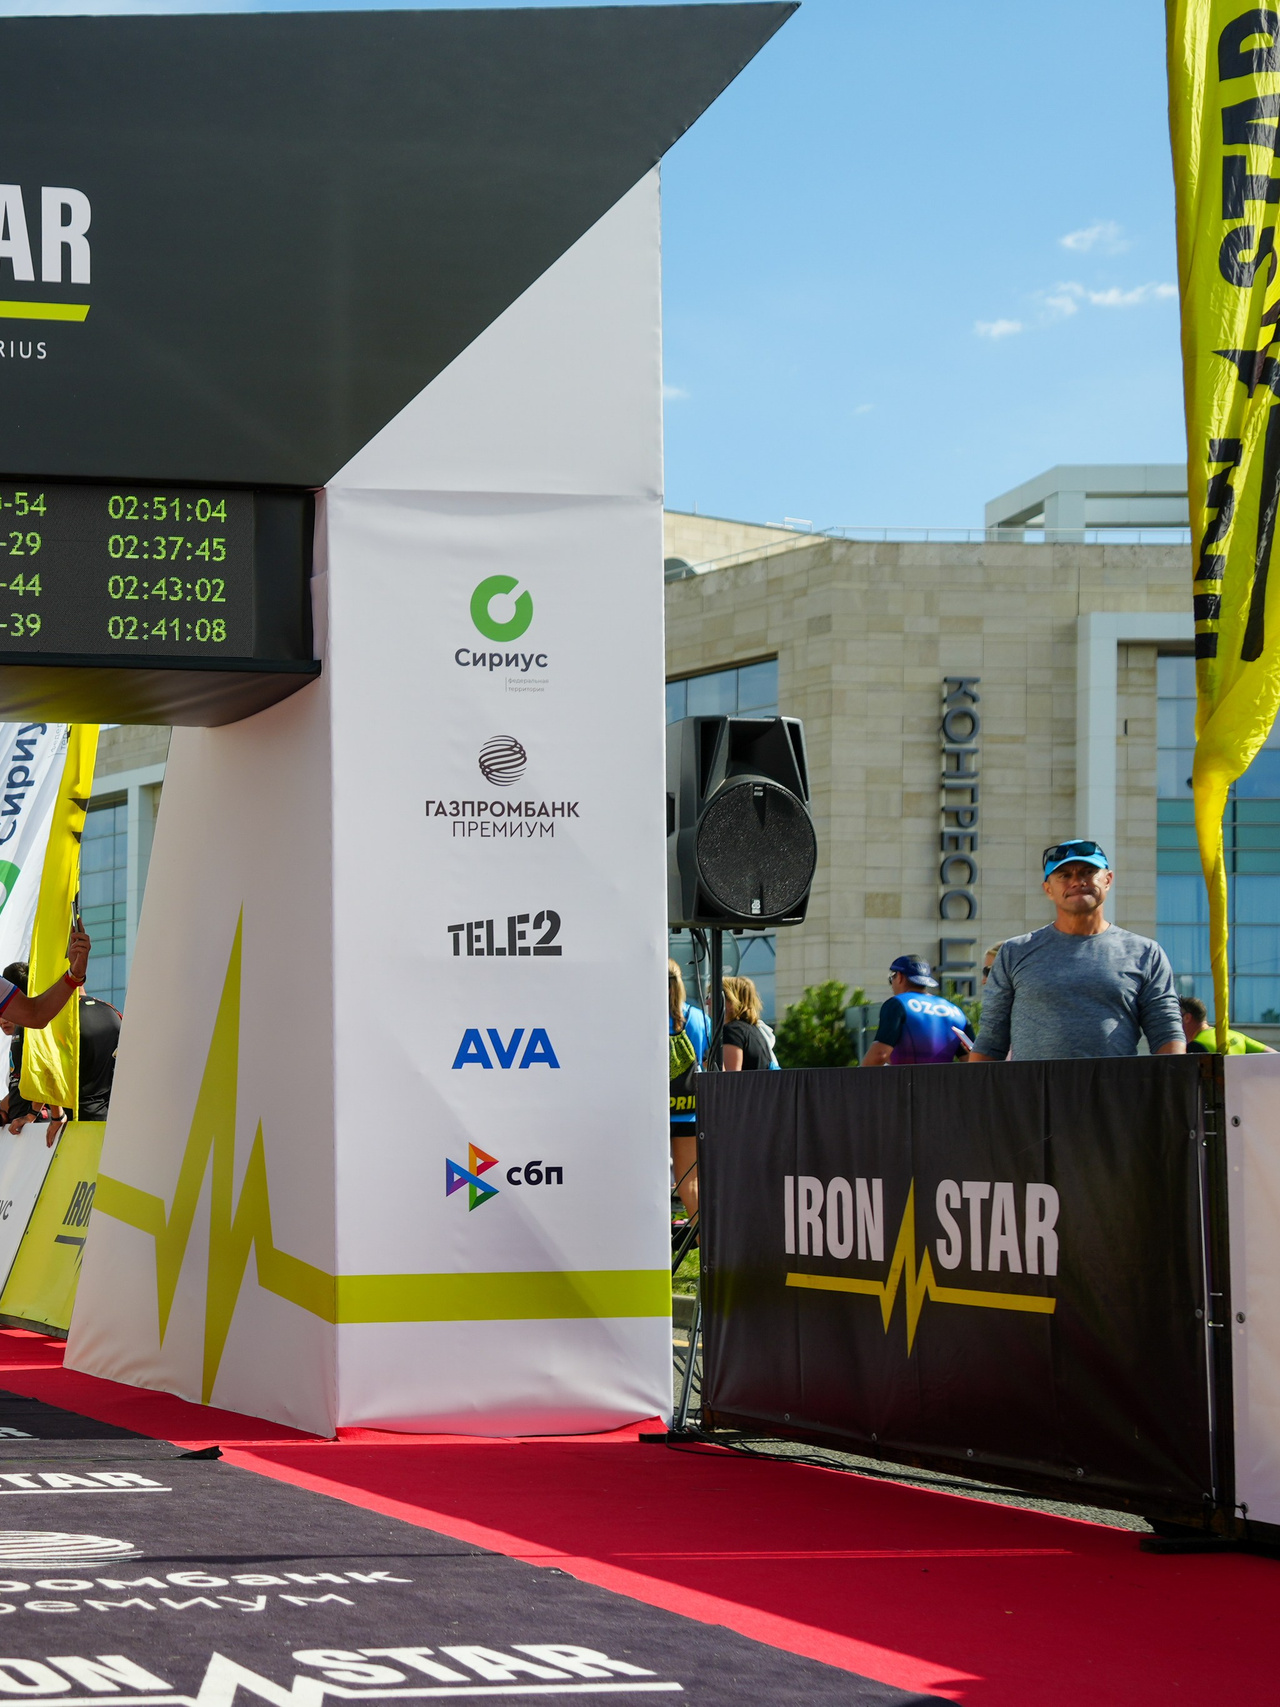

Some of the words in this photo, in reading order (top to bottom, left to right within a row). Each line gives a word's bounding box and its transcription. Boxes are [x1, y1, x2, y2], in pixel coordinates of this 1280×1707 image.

[108, 495, 227, 523] 02:51:04
[108, 535, 227, 562] 02:37:45
[108, 576, 227, 603] 02:43:02
[108, 616, 227, 642] 02:41:08
[454, 648, 549, 672] Сириус
[425, 800, 580, 818] ГАЗПРОМБАНК
[939, 676, 981, 920] КОНГРЕСС
[452, 820, 554, 837] ПРЕМИУМ
[447, 910, 562, 956] TELE2
[907, 998, 962, 1018] OZON
[451, 1028, 560, 1069] AVA
[506, 1160, 564, 1186] сбп
[62, 1181, 97, 1227] IRO
[784, 1175, 885, 1262] IRON
[935, 1179, 1060, 1276] STAR
[292, 1644, 658, 1684] STAR
